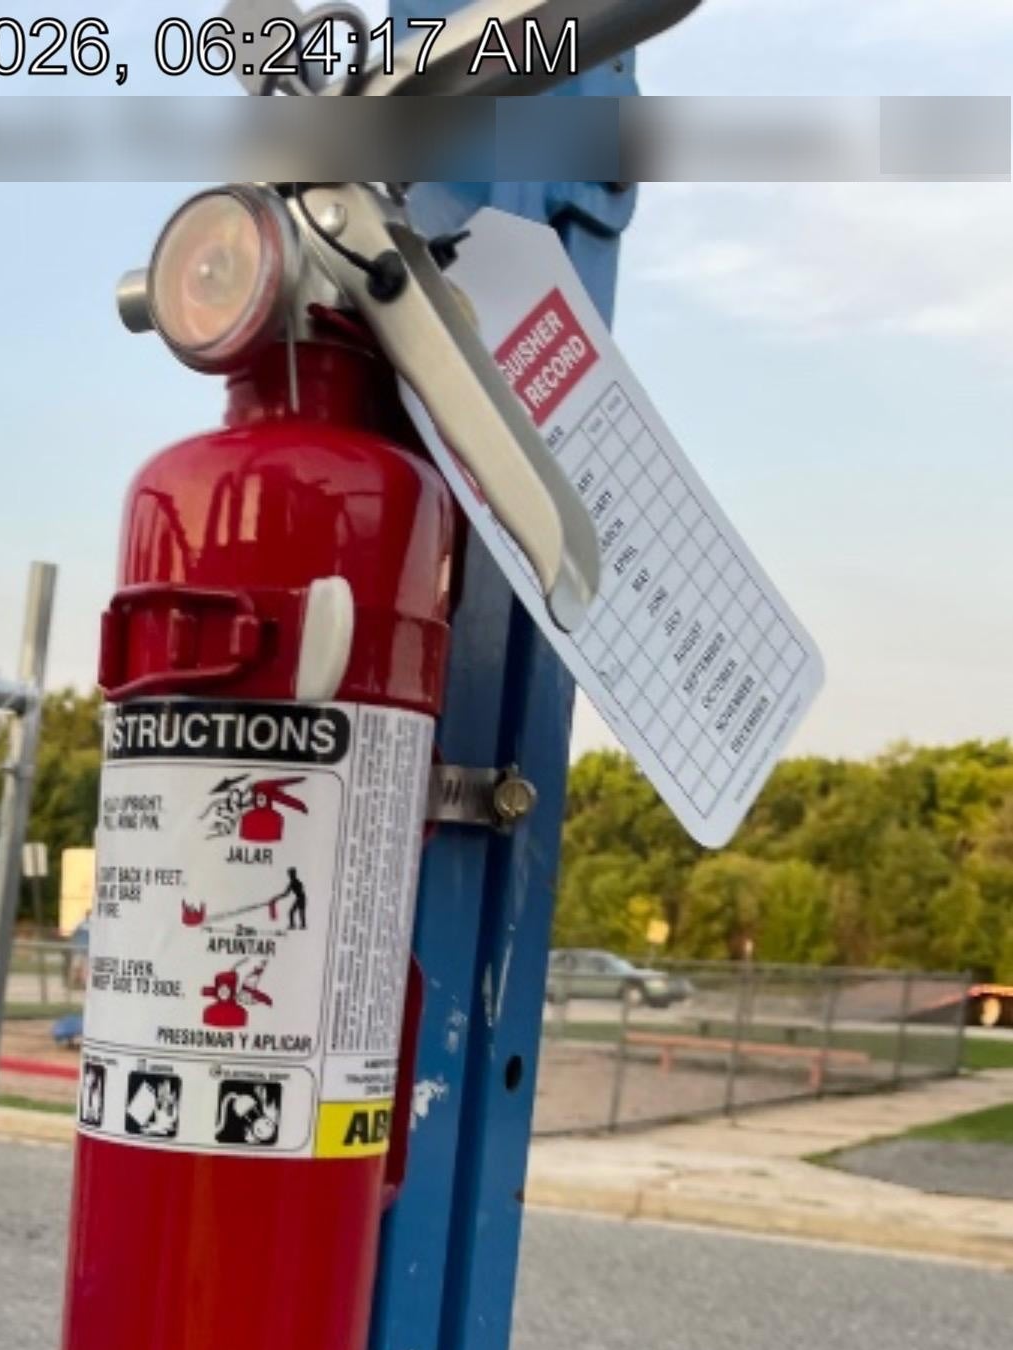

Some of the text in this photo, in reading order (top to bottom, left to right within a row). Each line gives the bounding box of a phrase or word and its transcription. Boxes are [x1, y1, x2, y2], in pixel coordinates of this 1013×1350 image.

[523, 335, 587, 409] RECORD
[673, 619, 703, 667] AUGUST
[682, 631, 727, 695] SEPTEMBER
[701, 655, 739, 711] OCTOBER
[715, 673, 757, 738] NOVEMBER
[730, 694, 771, 755] DECEMBER
[226, 845, 274, 866] JALAR
[207, 936, 277, 956] APUNTAR
[238, 1031, 249, 1049] Y
[252, 1033, 313, 1053] APLICAR
